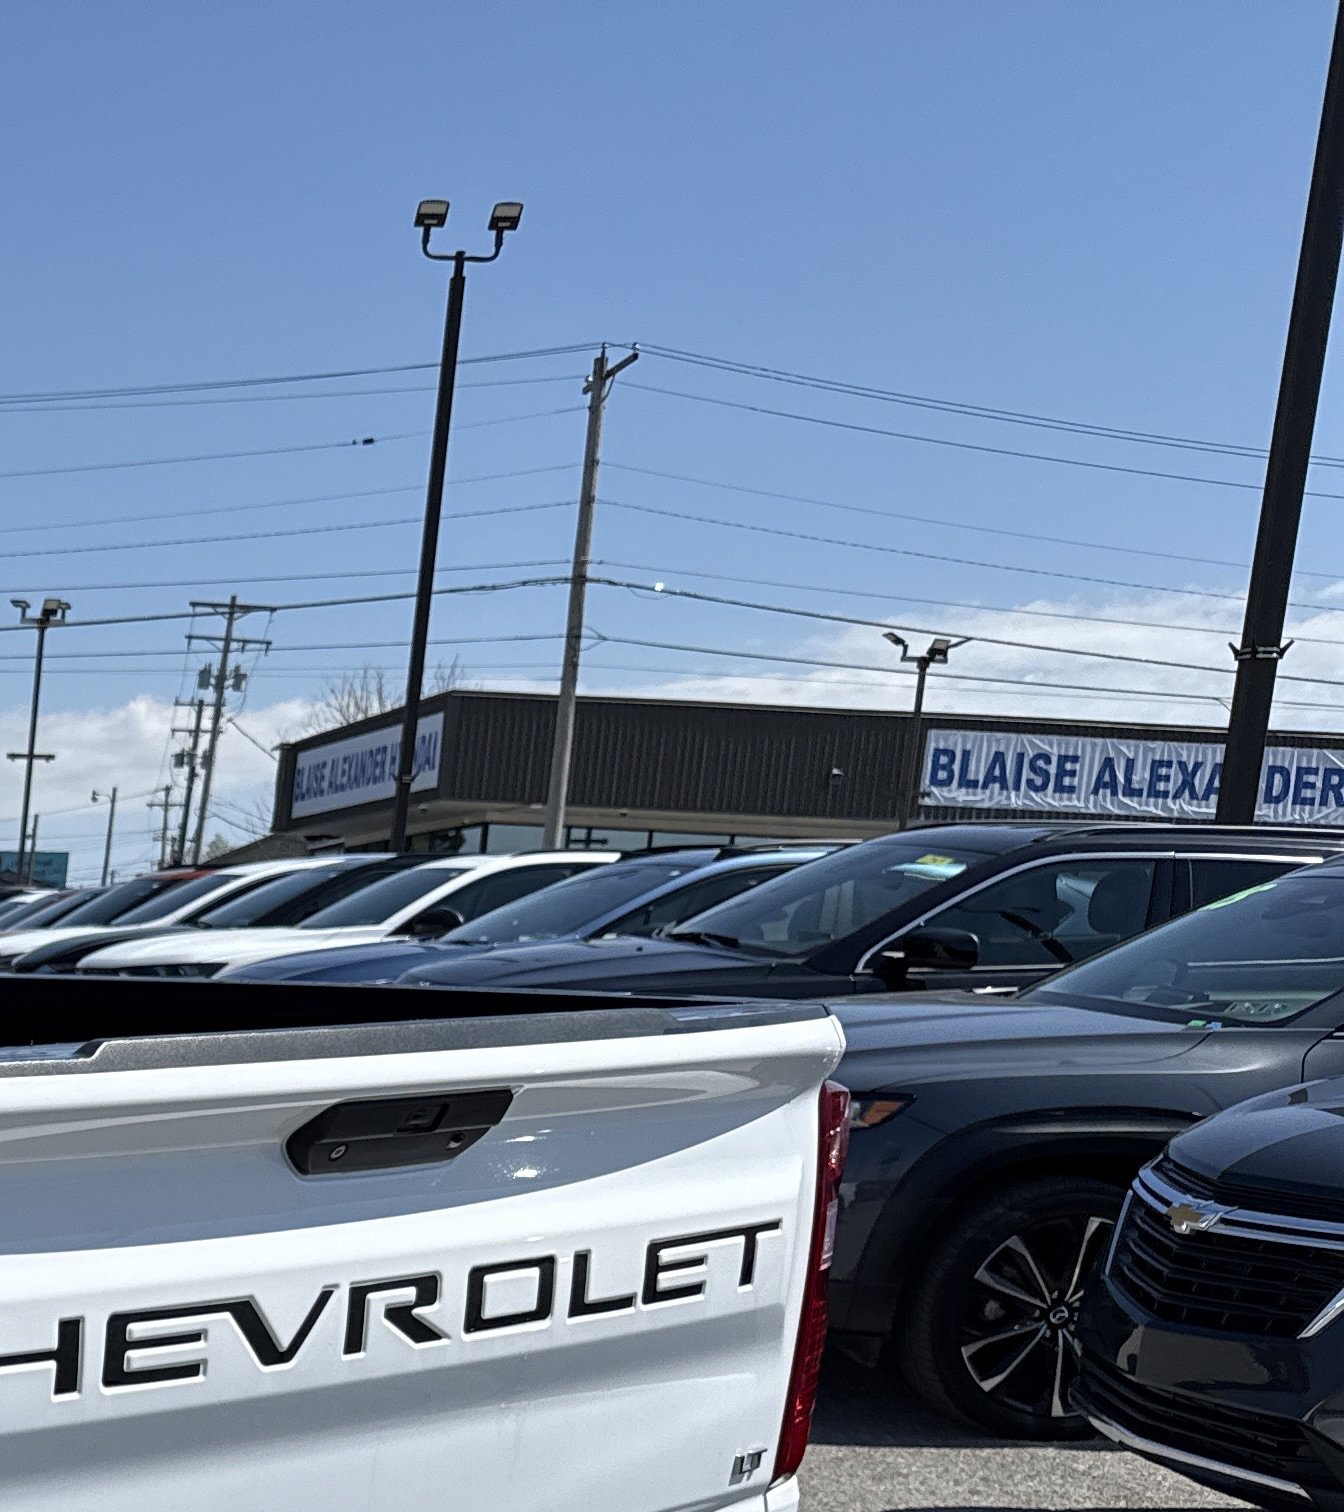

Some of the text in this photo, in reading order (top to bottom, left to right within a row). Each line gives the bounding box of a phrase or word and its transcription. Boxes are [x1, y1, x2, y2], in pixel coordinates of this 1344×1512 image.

[294, 760, 327, 802] BLAISE
[327, 745, 388, 794] ALEXANDER
[929, 746, 1344, 808] BLAISE ALEXADER
